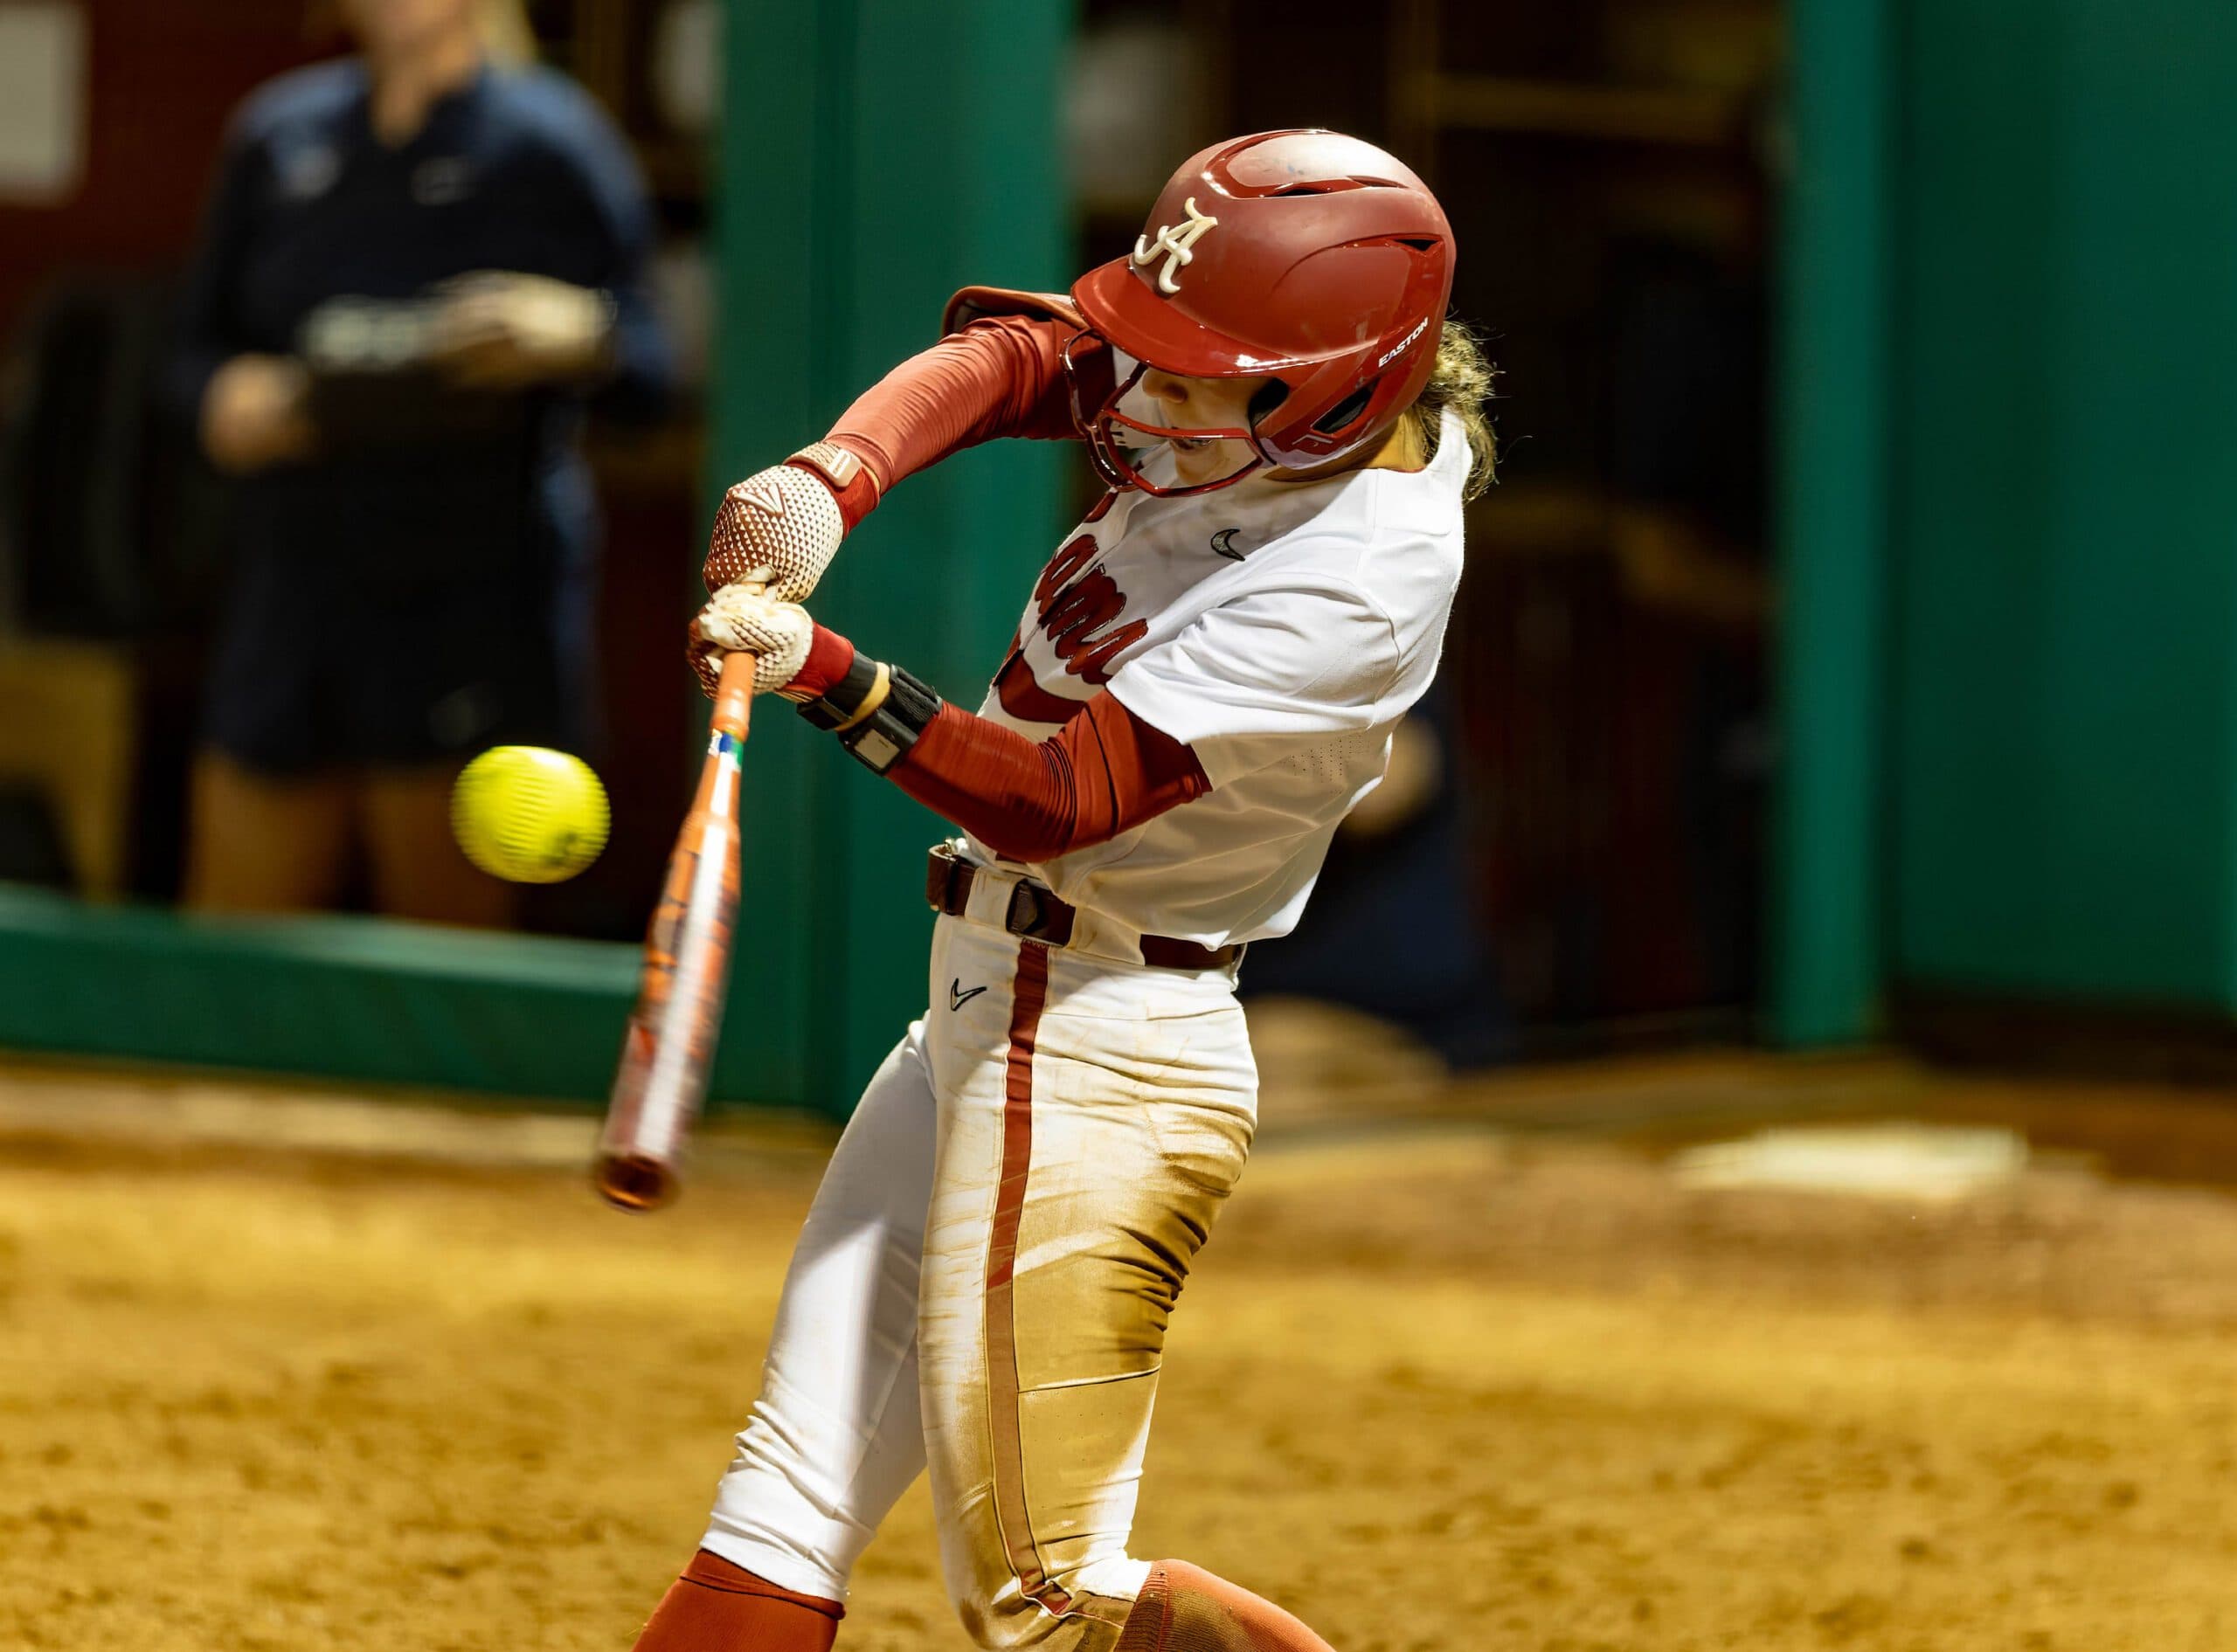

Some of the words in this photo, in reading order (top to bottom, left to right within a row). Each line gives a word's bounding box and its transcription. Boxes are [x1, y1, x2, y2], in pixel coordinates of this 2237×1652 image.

[1134, 197, 1218, 293] A
[1378, 316, 1429, 367] EASTON
[1035, 491, 1149, 685] ama
